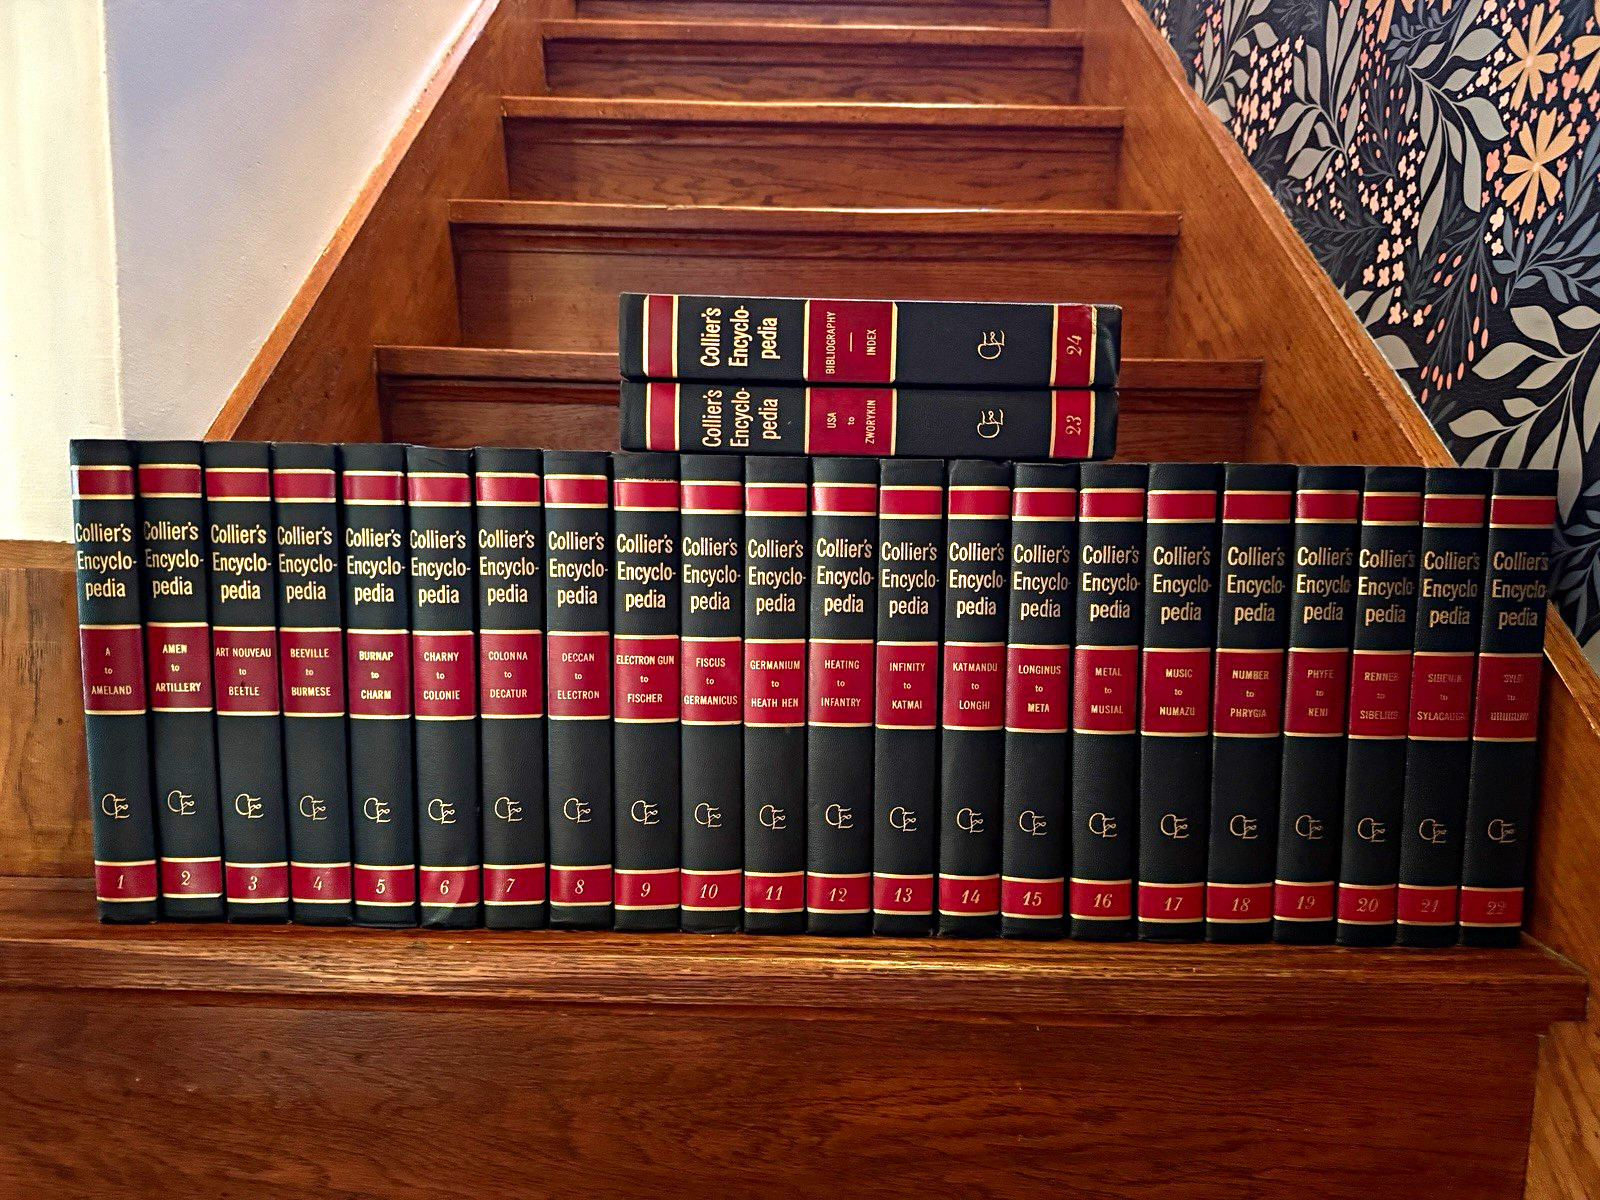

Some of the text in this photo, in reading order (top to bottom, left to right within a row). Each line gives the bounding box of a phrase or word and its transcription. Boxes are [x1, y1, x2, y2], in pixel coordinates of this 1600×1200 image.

[700, 308, 721, 366] Collier's
[729, 306, 752, 366] Encyclo-
[757, 318, 780, 359] pedia
[826, 312, 835, 374] BIBLIOGRAPHY
[867, 330, 876, 355] INDEX
[1067, 335, 1082, 355] 24
[702, 390, 722, 446] Collier's
[730, 388, 753, 446] Encyclo-
[758, 399, 781, 439] pedia
[827, 413, 836, 428] USA
[847, 416, 855, 426] to
[866, 400, 875, 444] ZWORYKIN
[1066, 416, 1081, 435] 23
[75, 523, 132, 543] Collier's
[144, 522, 199, 542] Collier's
[212, 524, 266, 543] Collier's
[278, 526, 332, 545] Collier's
[346, 528, 401, 547] Collier's
[410, 530, 465, 549] Collier's
[479, 529, 534, 548] Collier's
[548, 531, 604, 550] Collier's
[617, 534, 672, 553] Collier's
[683, 537, 737, 556] Collier's
[748, 539, 803, 559] Collier's
[816, 538, 872, 559] Collier's
[881, 542, 937, 561] Collier's
[949, 542, 1004, 562] Collier's
[78, 552, 137, 571] Encyclo-
[146, 549, 203, 571] Encyclo-
[213, 552, 271, 575] Encyclo-
[1014, 544, 1070, 565] Collier's
[1083, 545, 1140, 566] Collier's
[1153, 546, 1210, 567] Collier's
[1227, 547, 1285, 567] Collier's
[1297, 547, 1353, 567] Collier's
[279, 554, 337, 576] Encyclo-
[348, 556, 405, 579] Encyclo-
[411, 558, 470, 577] Encyclo-
[480, 556, 539, 579] Encyclo-
[550, 558, 607, 581] Encyclo-
[618, 561, 676, 584] Encyclo-
[684, 564, 740, 587] Encyclo-
[748, 566, 806, 589] Encyclo-
[817, 567, 874, 587] Encyclo-
[882, 569, 939, 589] Encyclo-
[949, 569, 1006, 592] Encyclo-
[1013, 571, 1071, 594] Encyclo-
[1083, 572, 1140, 595] Encyclo-
[1153, 574, 1212, 596] Encyclo-
[86, 578, 125, 600] pedia
[153, 576, 193, 598] pedia
[221, 580, 260, 603] pedia
[287, 581, 326, 603] pedia
[355, 583, 394, 605] pedia
[419, 585, 459, 607] pedia
[488, 584, 527, 606] pedia
[558, 586, 597, 607] pedia
[626, 590, 665, 611] pedia
[691, 592, 730, 613] pedia
[756, 594, 795, 615] pedia
[824, 594, 864, 616] pedia
[889, 596, 929, 618] pedia
[957, 597, 996, 618] pedia
[1020, 599, 1061, 620] pedia
[1090, 600, 1130, 621] pedia
[1161, 602, 1202, 624] pedia
[1234, 603, 1275, 625] pedia
[1303, 603, 1344, 624] pedia
[1365, 605, 1406, 626] pedia
[1430, 606, 1470, 627] pedia
[1498, 608, 1538, 629] pedia
[105, 646, 111, 656] A
[163, 644, 187, 653] AMEN
[216, 648, 271, 657] ART NOUVEAU
[291, 649, 329, 658] BEEVILLE
[359, 651, 393, 660] BURNAP
[424, 652, 458, 661] CHARNY
[488, 651, 527, 660] COLONNA
[562, 653, 594, 662] DECCAN
[170, 663, 180, 672] to
[616, 656, 675, 665] ELECTRON GUN
[696, 658, 725, 667] FISCUS
[750, 660, 799, 669] GERMANIUM
[825, 660, 859, 669] HEATING
[890, 663, 925, 671] INFINITY
[953, 663, 996, 671] KATMANDU
[1019, 665, 1060, 674] LONGINUS
[104, 666, 113, 675] to
[238, 668, 247, 676] to
[305, 668, 314, 676] to
[370, 671, 380, 679] to
[435, 671, 446, 680] to
[503, 670, 512, 679] to
[574, 672, 583, 680] to
[639, 675, 649, 683] to
[1095, 667, 1121, 676] METAL
[1165, 669, 1193, 678] MUSIC
[92, 686, 132, 694] AMELAND
[156, 683, 201, 692] ARTILLERY
[705, 677, 715, 685] to
[771, 680, 780, 688] to
[836, 679, 846, 687] to
[229, 687, 259, 695] BEETLE
[292, 687, 330, 696] BURMESE
[361, 690, 391, 699] CHARM
[424, 691, 459, 700] COLONIE
[490, 689, 526, 698] DECATUR
[557, 690, 599, 699] ELECTRON
[627, 693, 662, 703] FISCHER
[684, 694, 737, 705] GERMANICUS
[751, 698, 798, 707] HEATH HEN
[821, 698, 860, 706] INFANTRY
[892, 701, 921, 709] KATMAI
[960, 700, 989, 709] LONGHI
[1028, 703, 1049, 712] META
[118, 875, 123, 888] 1
[182, 871, 190, 885] 2
[249, 876, 257, 890] 3
[314, 877, 322, 890] 4
[376, 879, 385, 893] 5
[441, 880, 449, 894] 6
[507, 878, 515, 892] 7
[575, 880, 584, 894] 8
[641, 883, 650, 897] 9
[701, 884, 717, 898] 10
[766, 886, 782, 900] 11
[830, 888, 847, 902] 12
[895, 888, 912, 902] 13
[962, 890, 979, 903] 14
[1023, 892, 1041, 906] 15
[1094, 893, 1112, 908] 16
[1165, 896, 1183, 911] 17
[1232, 897, 1250, 912] 18
[1297, 896, 1315, 909] 19
[1357, 898, 1379, 912] 20
